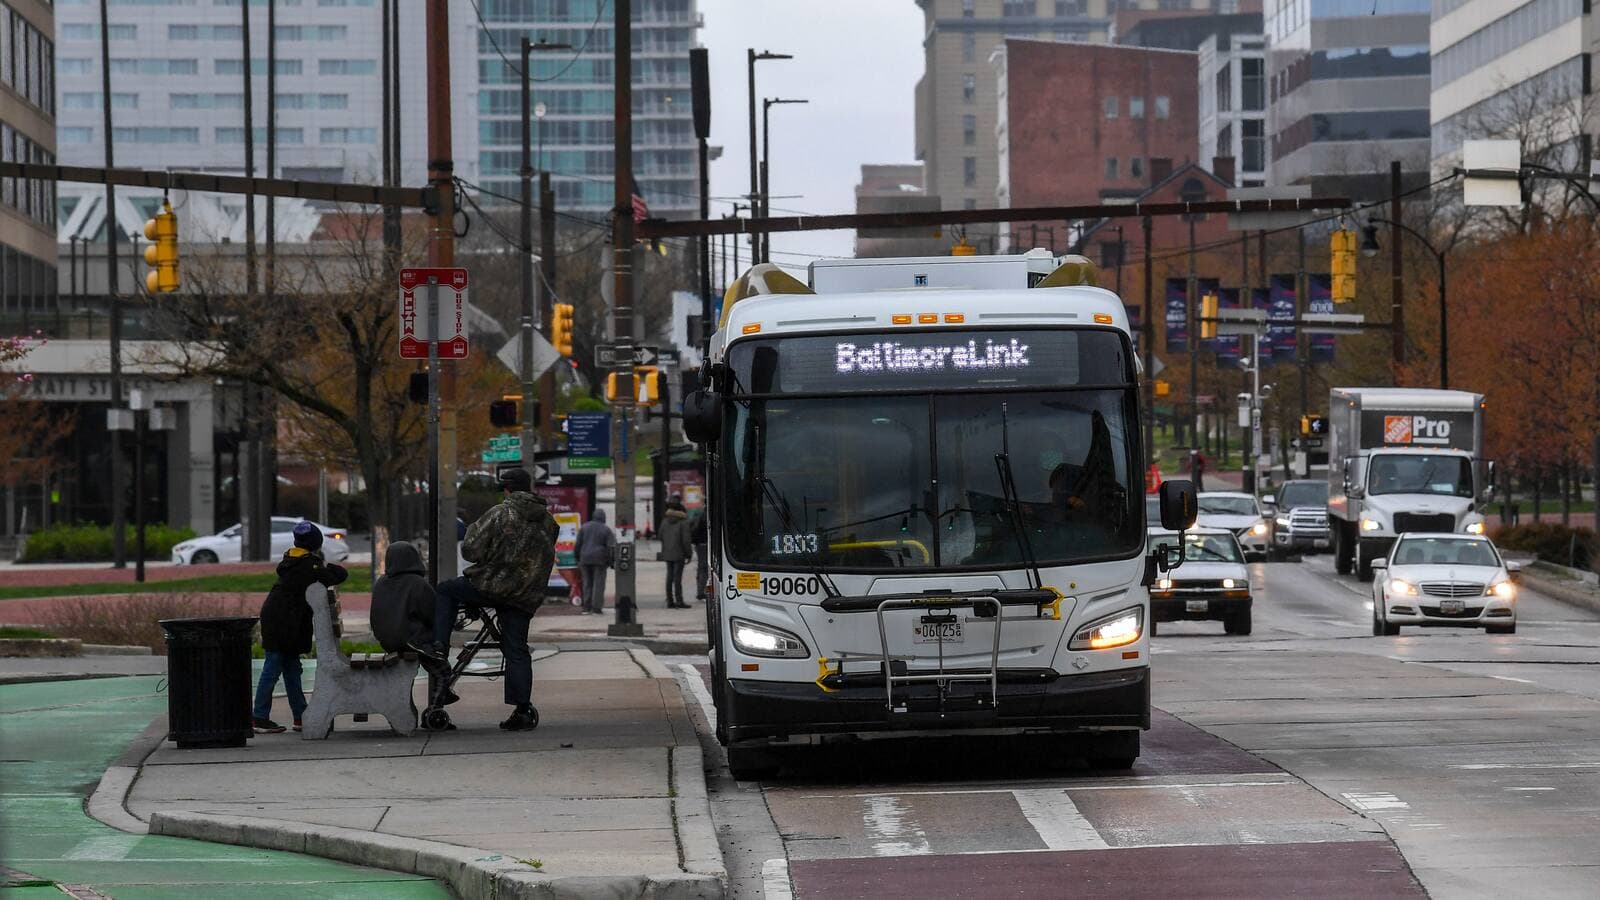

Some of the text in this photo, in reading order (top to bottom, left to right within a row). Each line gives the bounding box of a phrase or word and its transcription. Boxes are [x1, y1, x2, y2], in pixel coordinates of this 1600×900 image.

[403, 296, 415, 330] LINK
[835, 338, 1029, 372] BaltimoreLink
[1413, 416, 1450, 437] Pro
[771, 533, 818, 554] 1803
[760, 577, 819, 596] 19060
